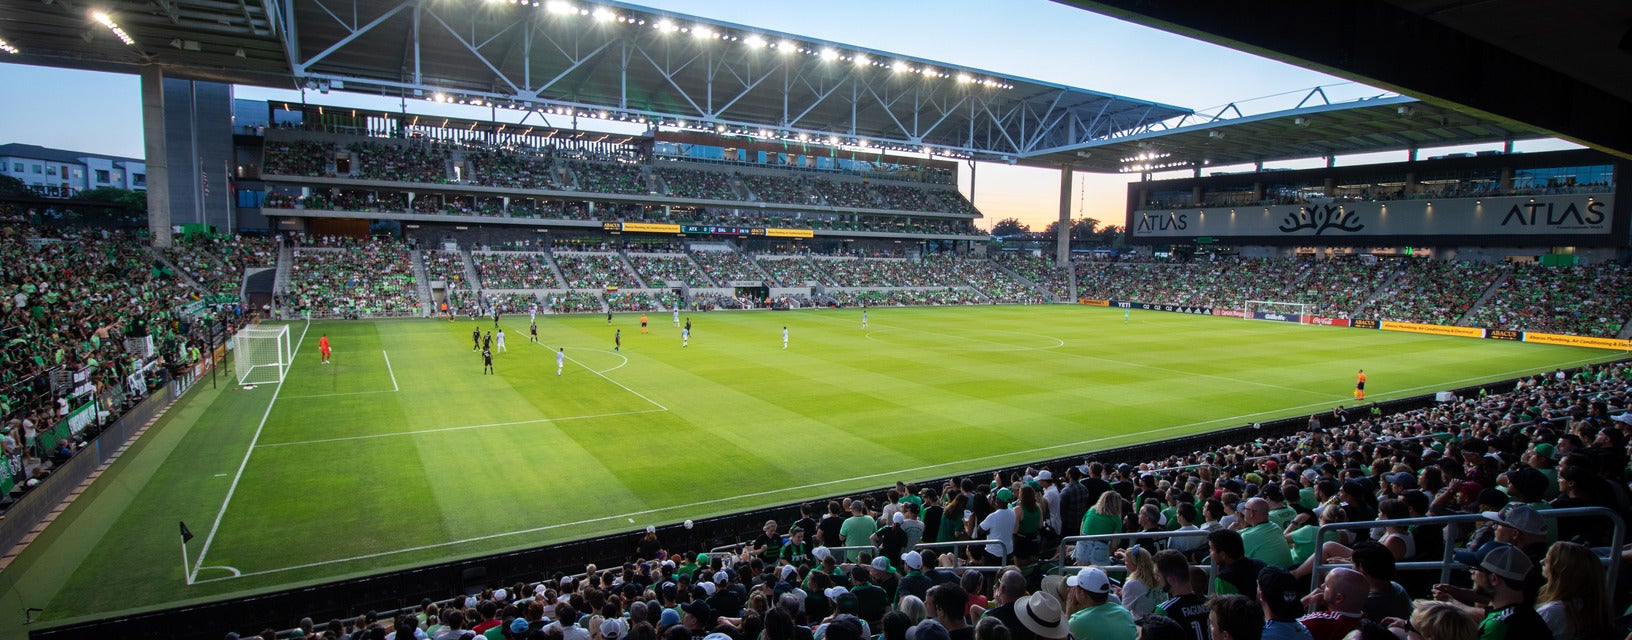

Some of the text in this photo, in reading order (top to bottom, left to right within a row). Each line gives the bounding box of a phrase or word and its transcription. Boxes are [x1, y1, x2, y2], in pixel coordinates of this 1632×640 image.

[1500, 201, 1605, 226] ATLAS
[1137, 214, 1188, 231] ATLAS
[1265, 313, 1287, 321] Gillette
